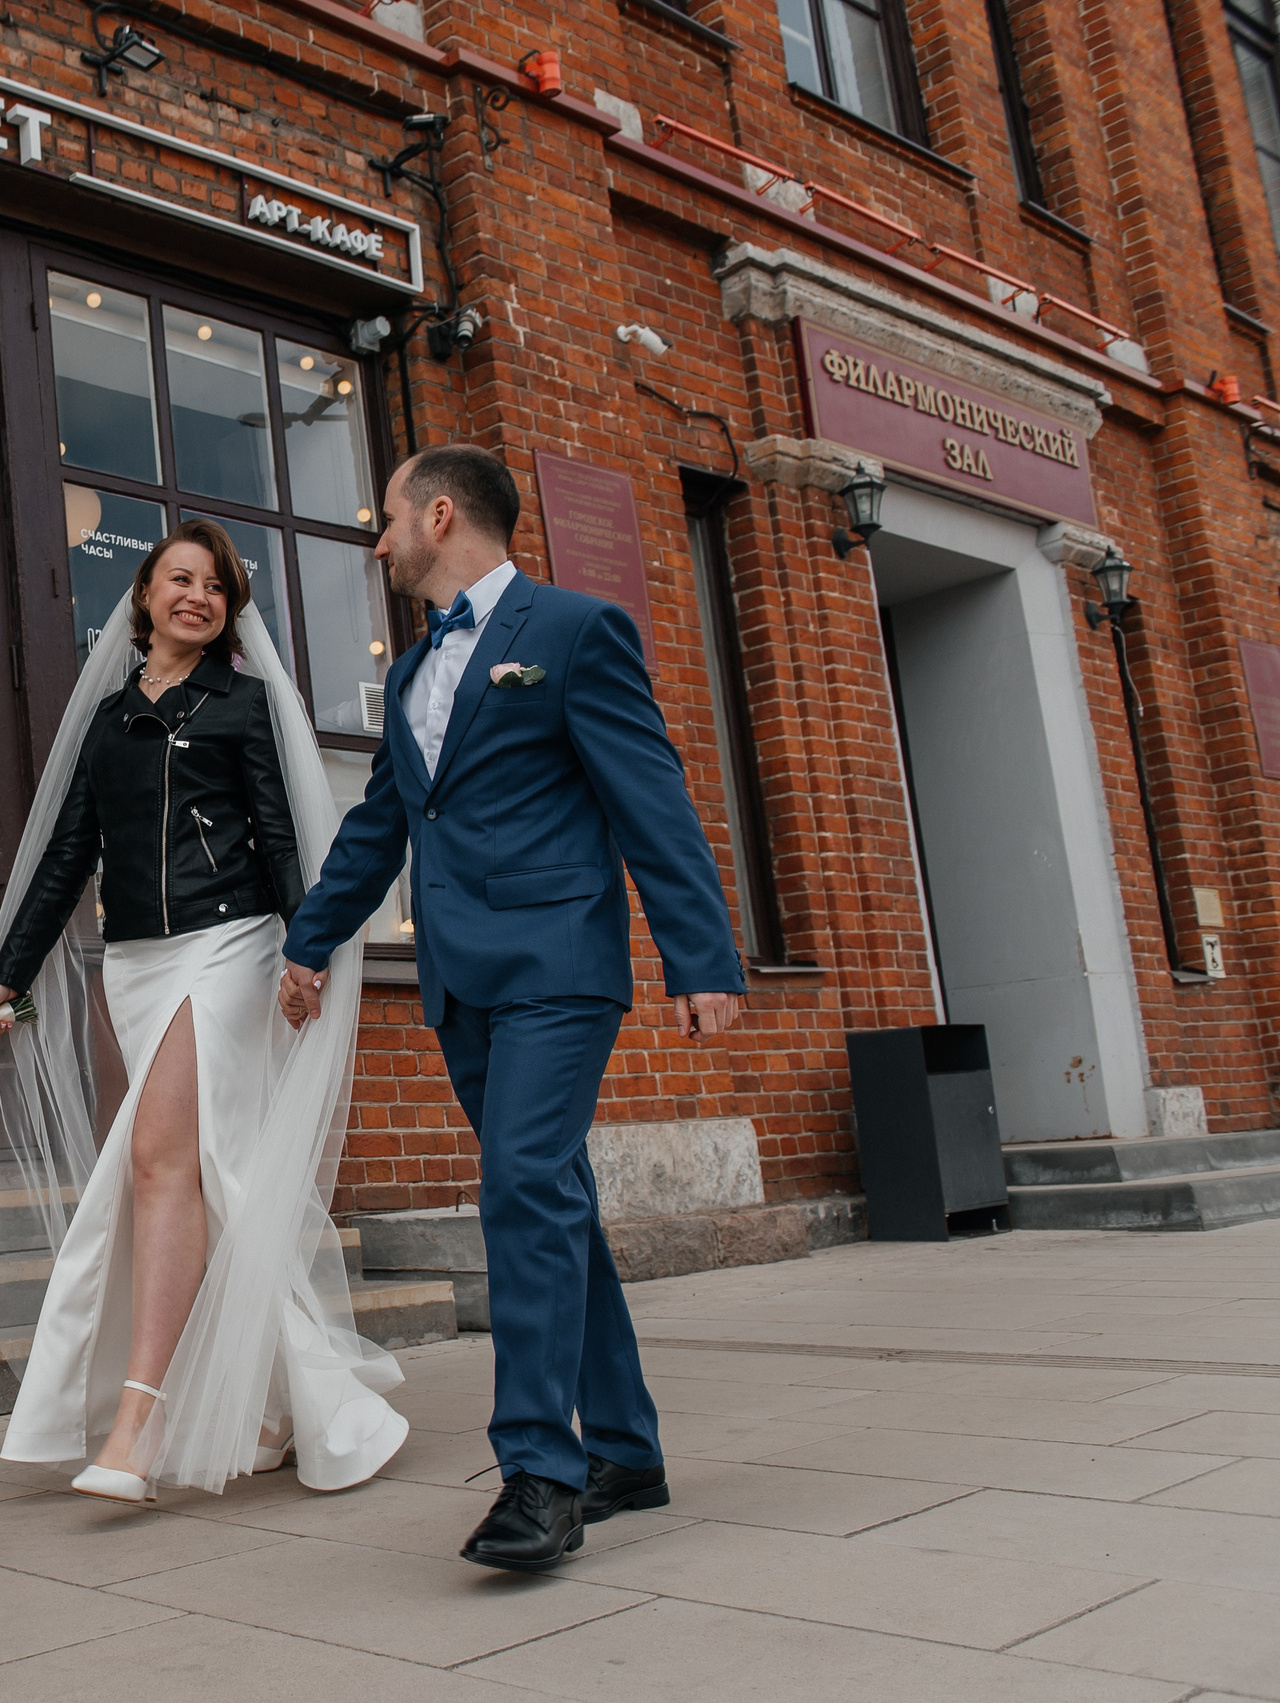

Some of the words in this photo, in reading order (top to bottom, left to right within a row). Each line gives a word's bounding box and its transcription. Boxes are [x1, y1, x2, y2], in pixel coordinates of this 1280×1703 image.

[248, 194, 384, 260] АРТ-КАФЕ
[823, 349, 1081, 469] ФИЛАРМОНИЧЕСКИЙ
[943, 437, 994, 481] ЗАЛ
[80, 528, 154, 553] СЧАСТЛИВЫЕ
[81, 543, 113, 559] ЧАСЫ
